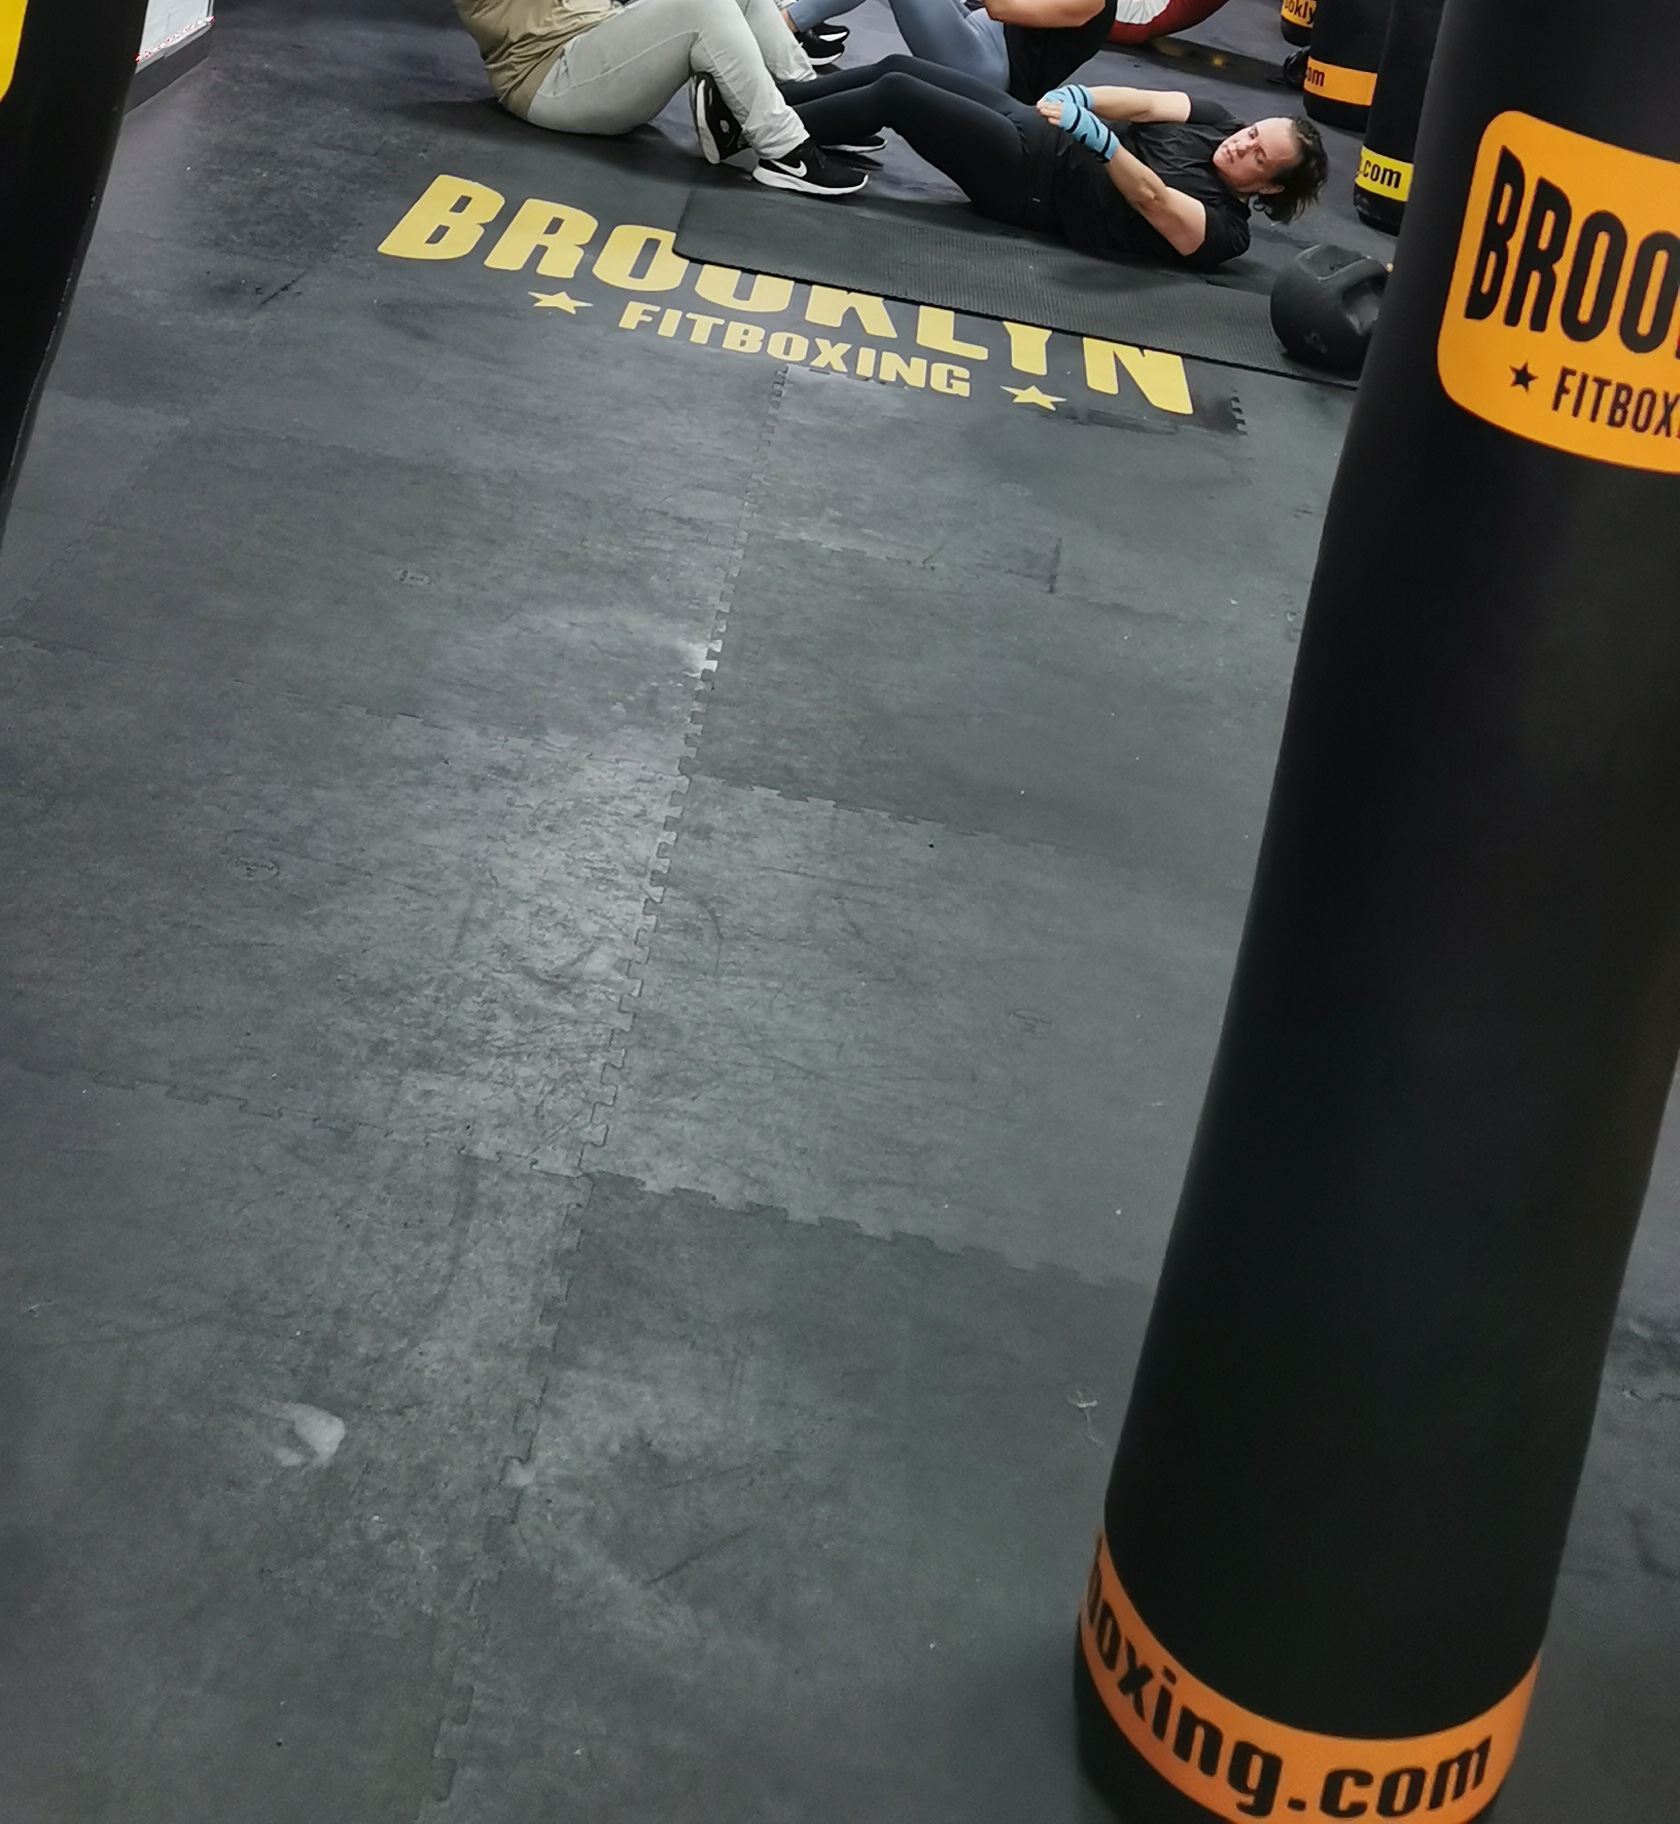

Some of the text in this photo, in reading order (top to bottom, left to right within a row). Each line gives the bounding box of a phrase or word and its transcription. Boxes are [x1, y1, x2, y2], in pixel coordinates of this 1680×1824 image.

[1464, 145, 1680, 360] BROO
[618, 301, 971, 398] FITBOXING
[1552, 366, 1680, 440] FITBOX
